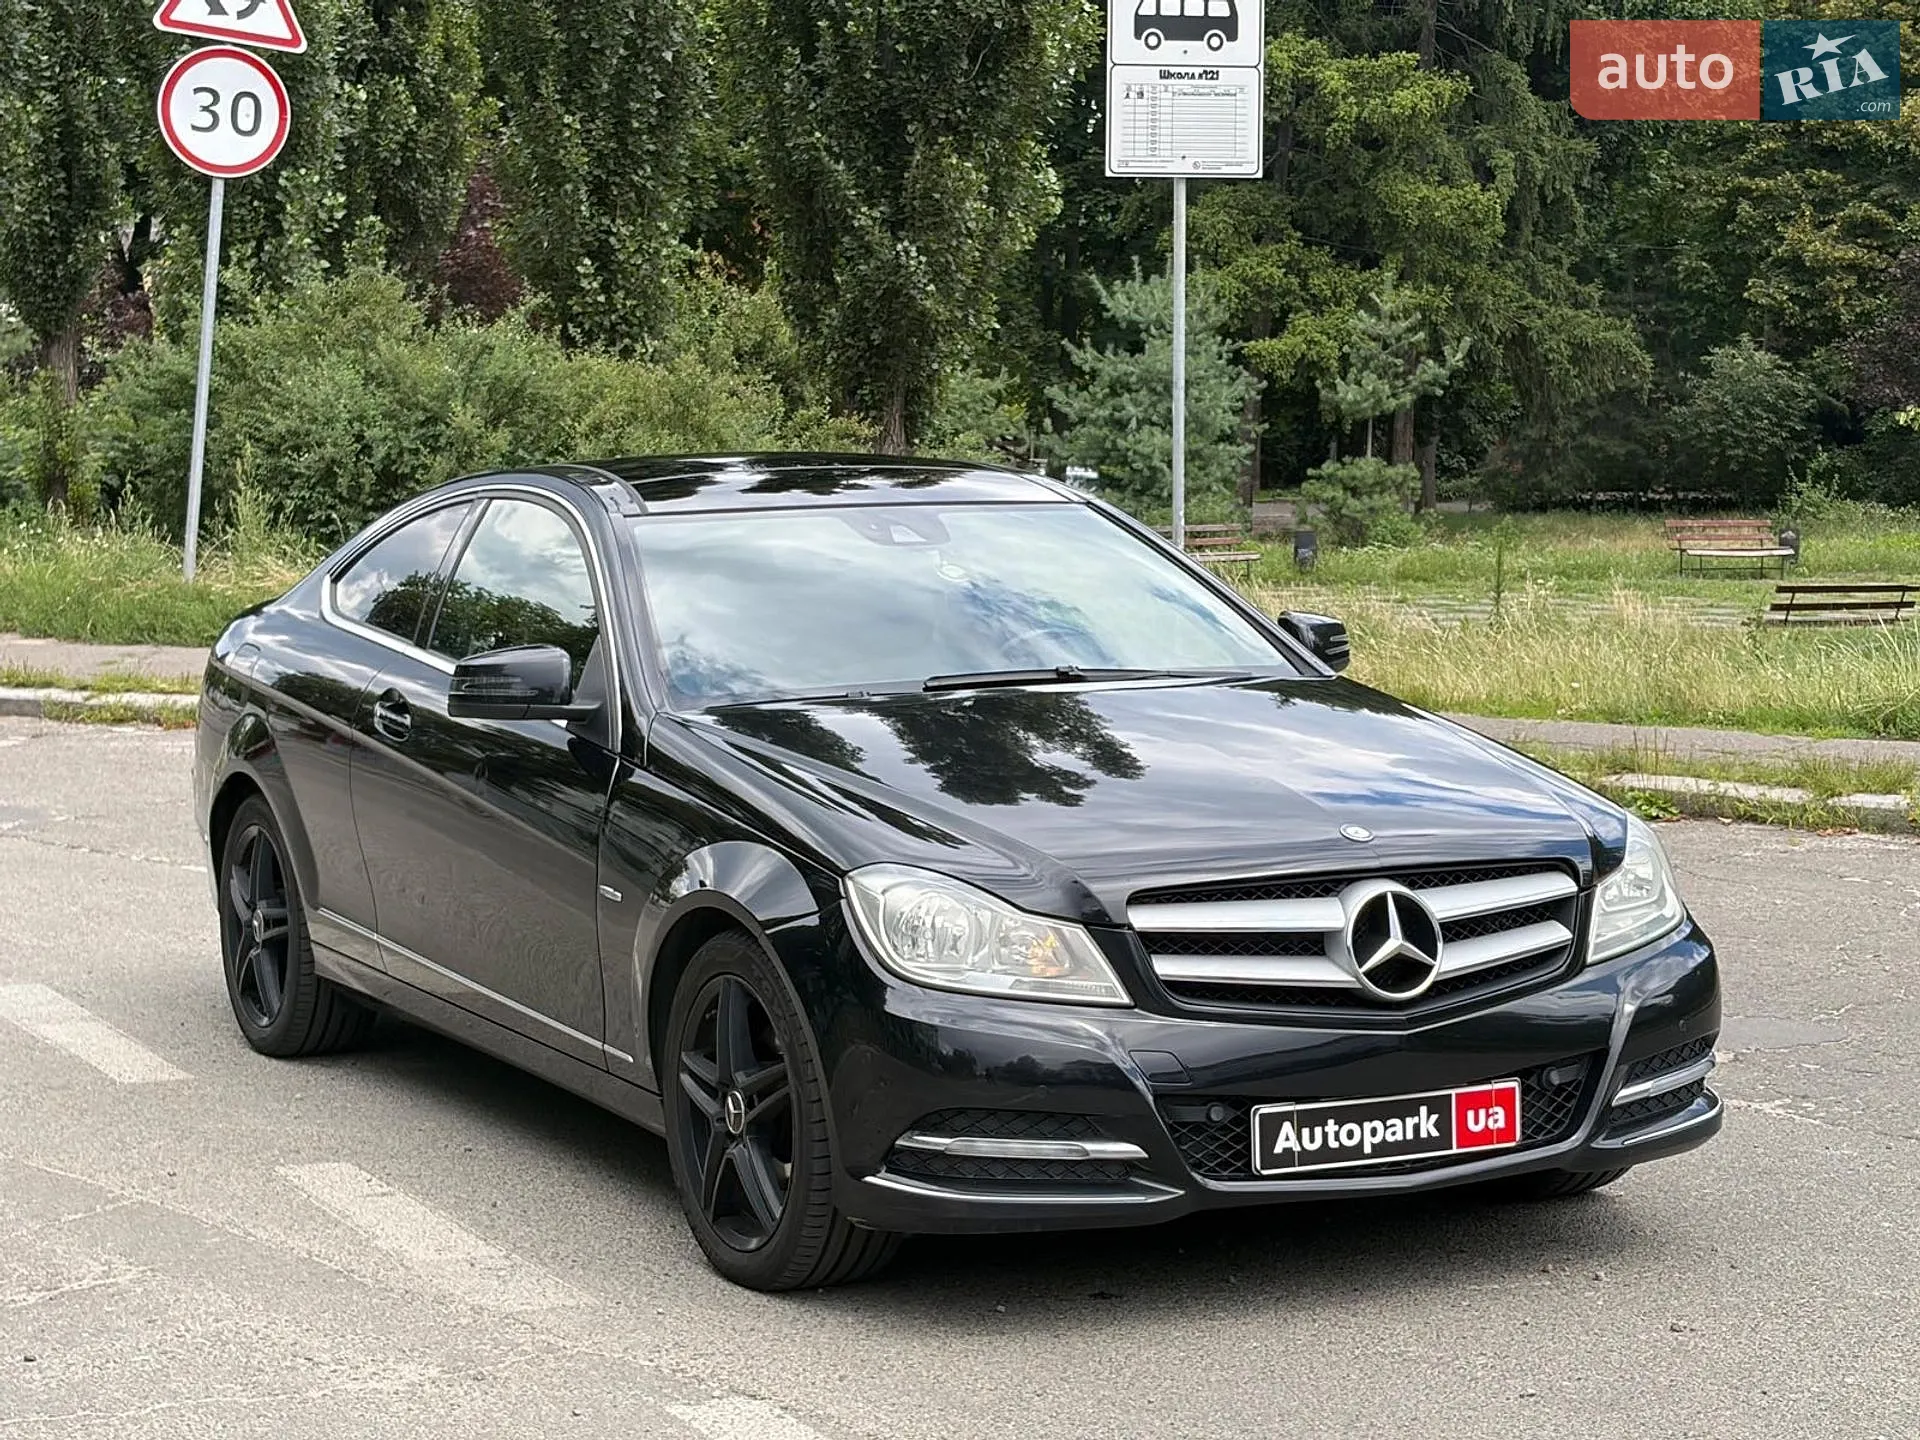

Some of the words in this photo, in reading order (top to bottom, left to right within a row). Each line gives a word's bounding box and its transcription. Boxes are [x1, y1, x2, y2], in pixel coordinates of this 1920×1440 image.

[1159, 69, 1196, 80] Школа
[190, 86, 262, 137] 30
[1273, 1105, 1440, 1154] Autopark
[1466, 1105, 1506, 1133] ua
